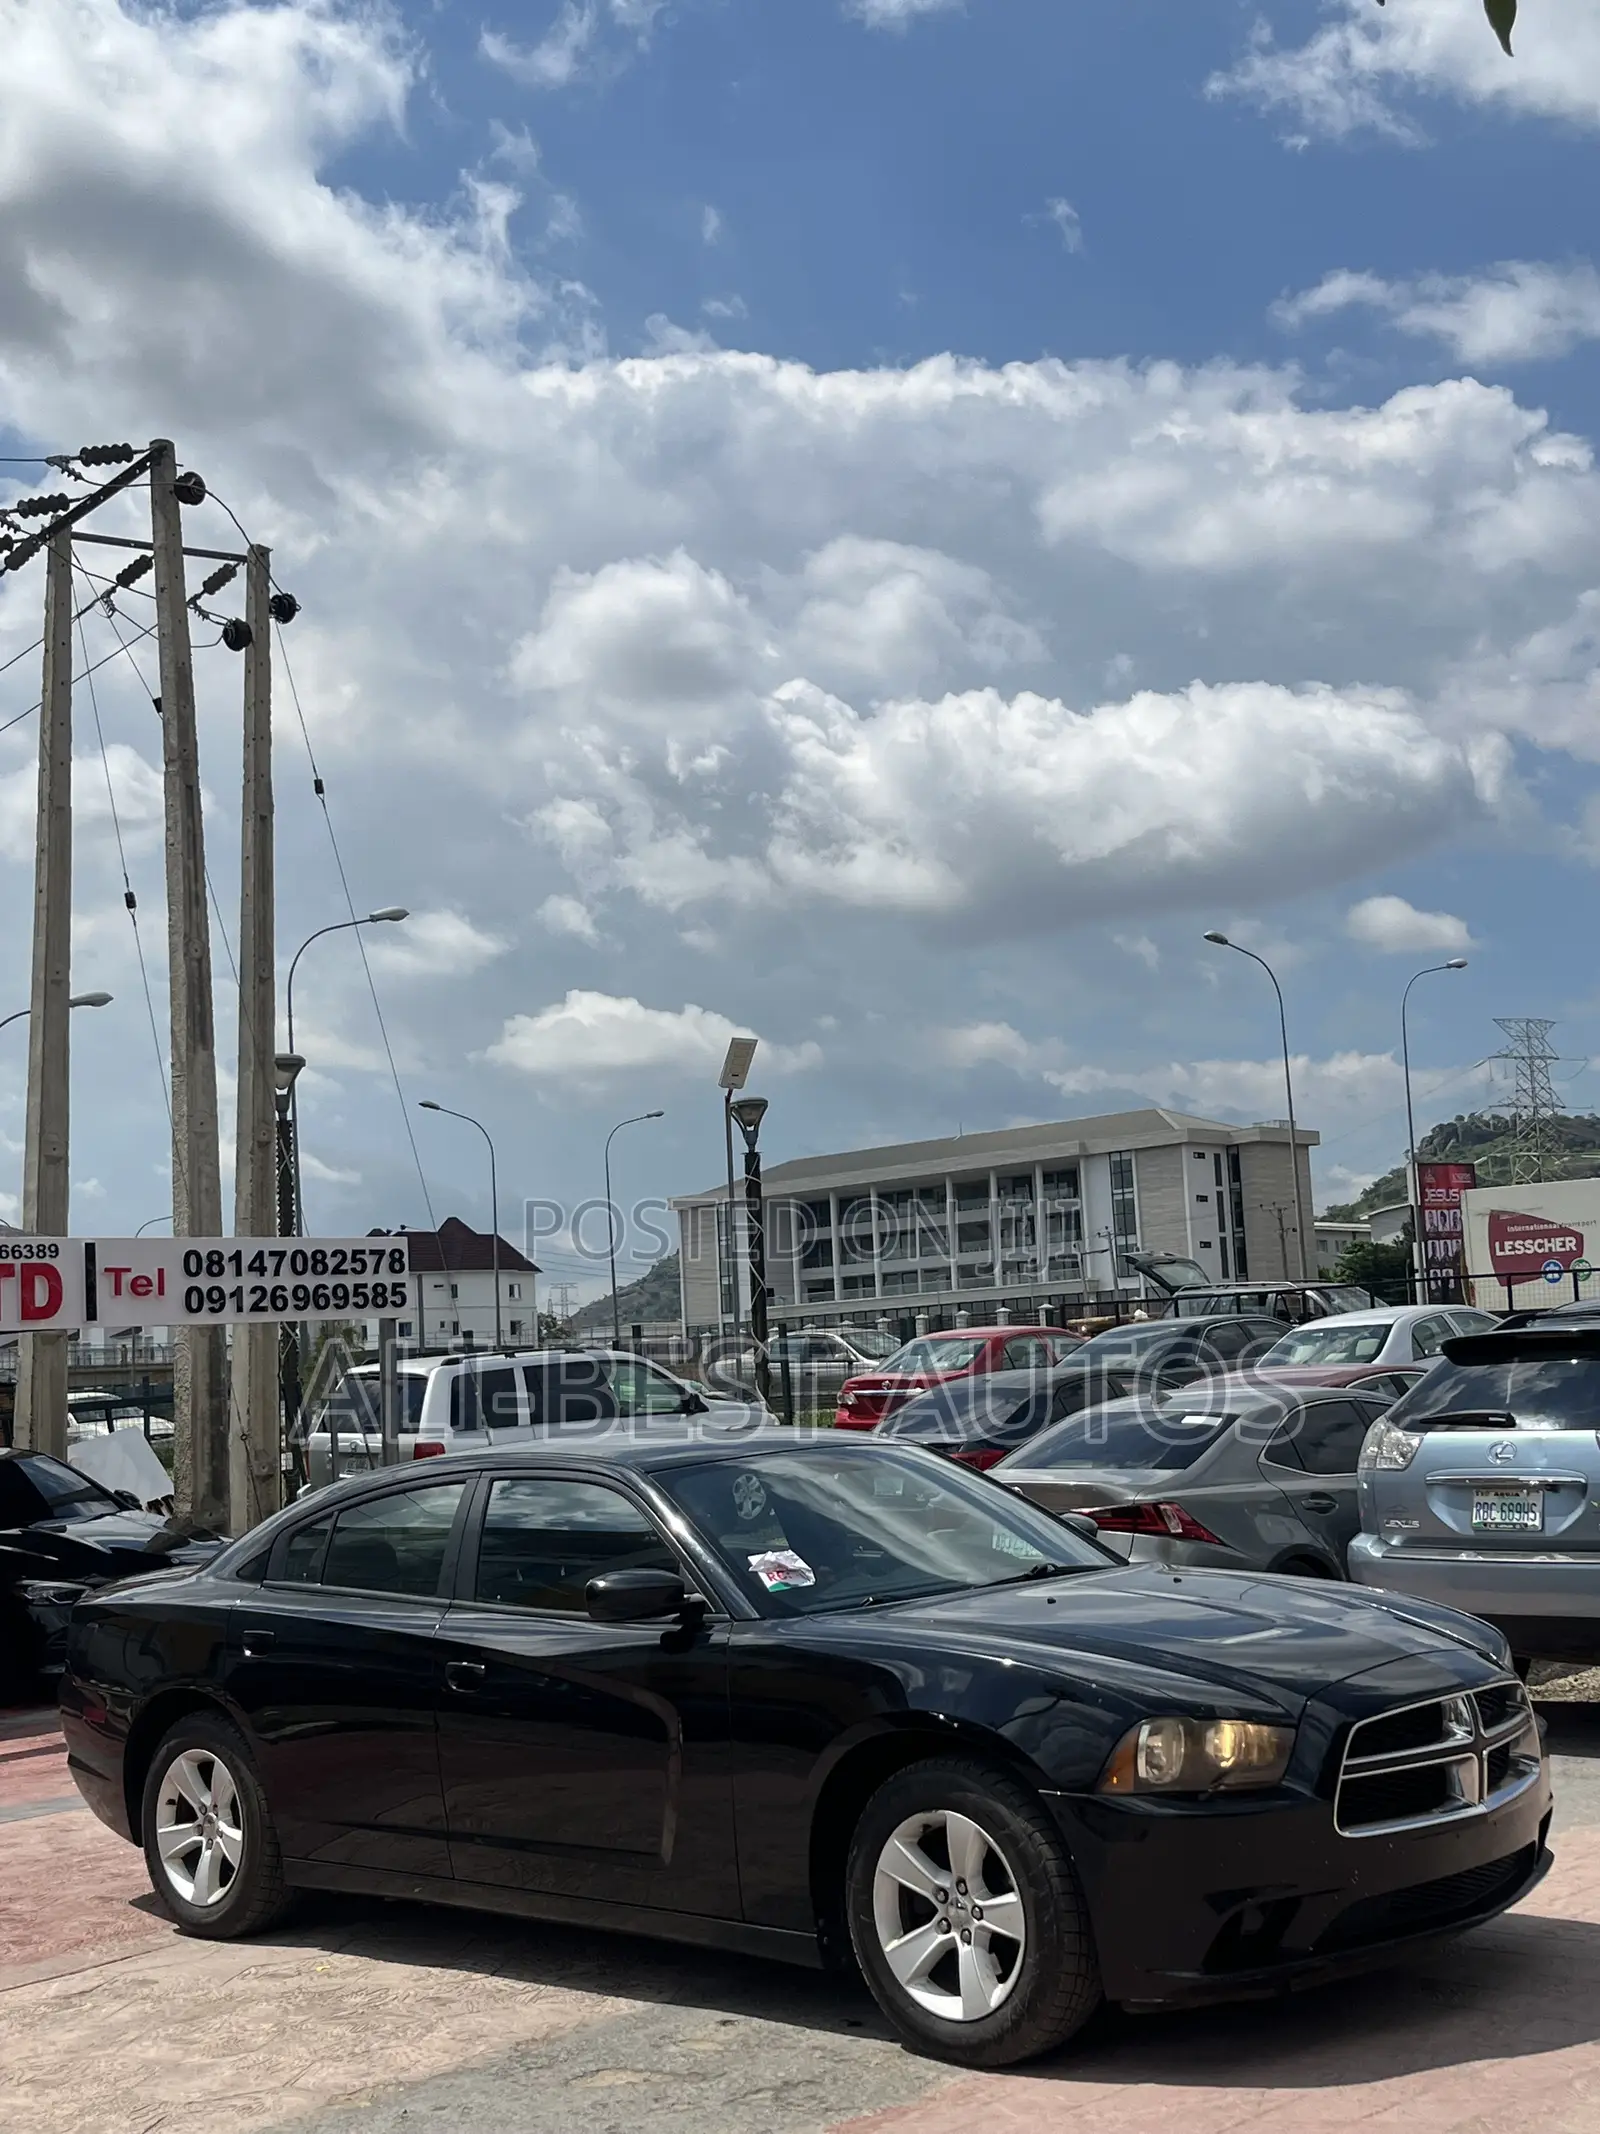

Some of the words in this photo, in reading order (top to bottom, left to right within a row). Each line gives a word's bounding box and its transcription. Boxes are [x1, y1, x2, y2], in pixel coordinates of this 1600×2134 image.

[1424, 1187, 1460, 1202] JESUS
[1494, 1236, 1578, 1256] LESSCHER
[182, 1248, 406, 1278] 08147082578
[103, 1266, 166, 1298] Tel
[184, 1282, 408, 1314] 09126969585
